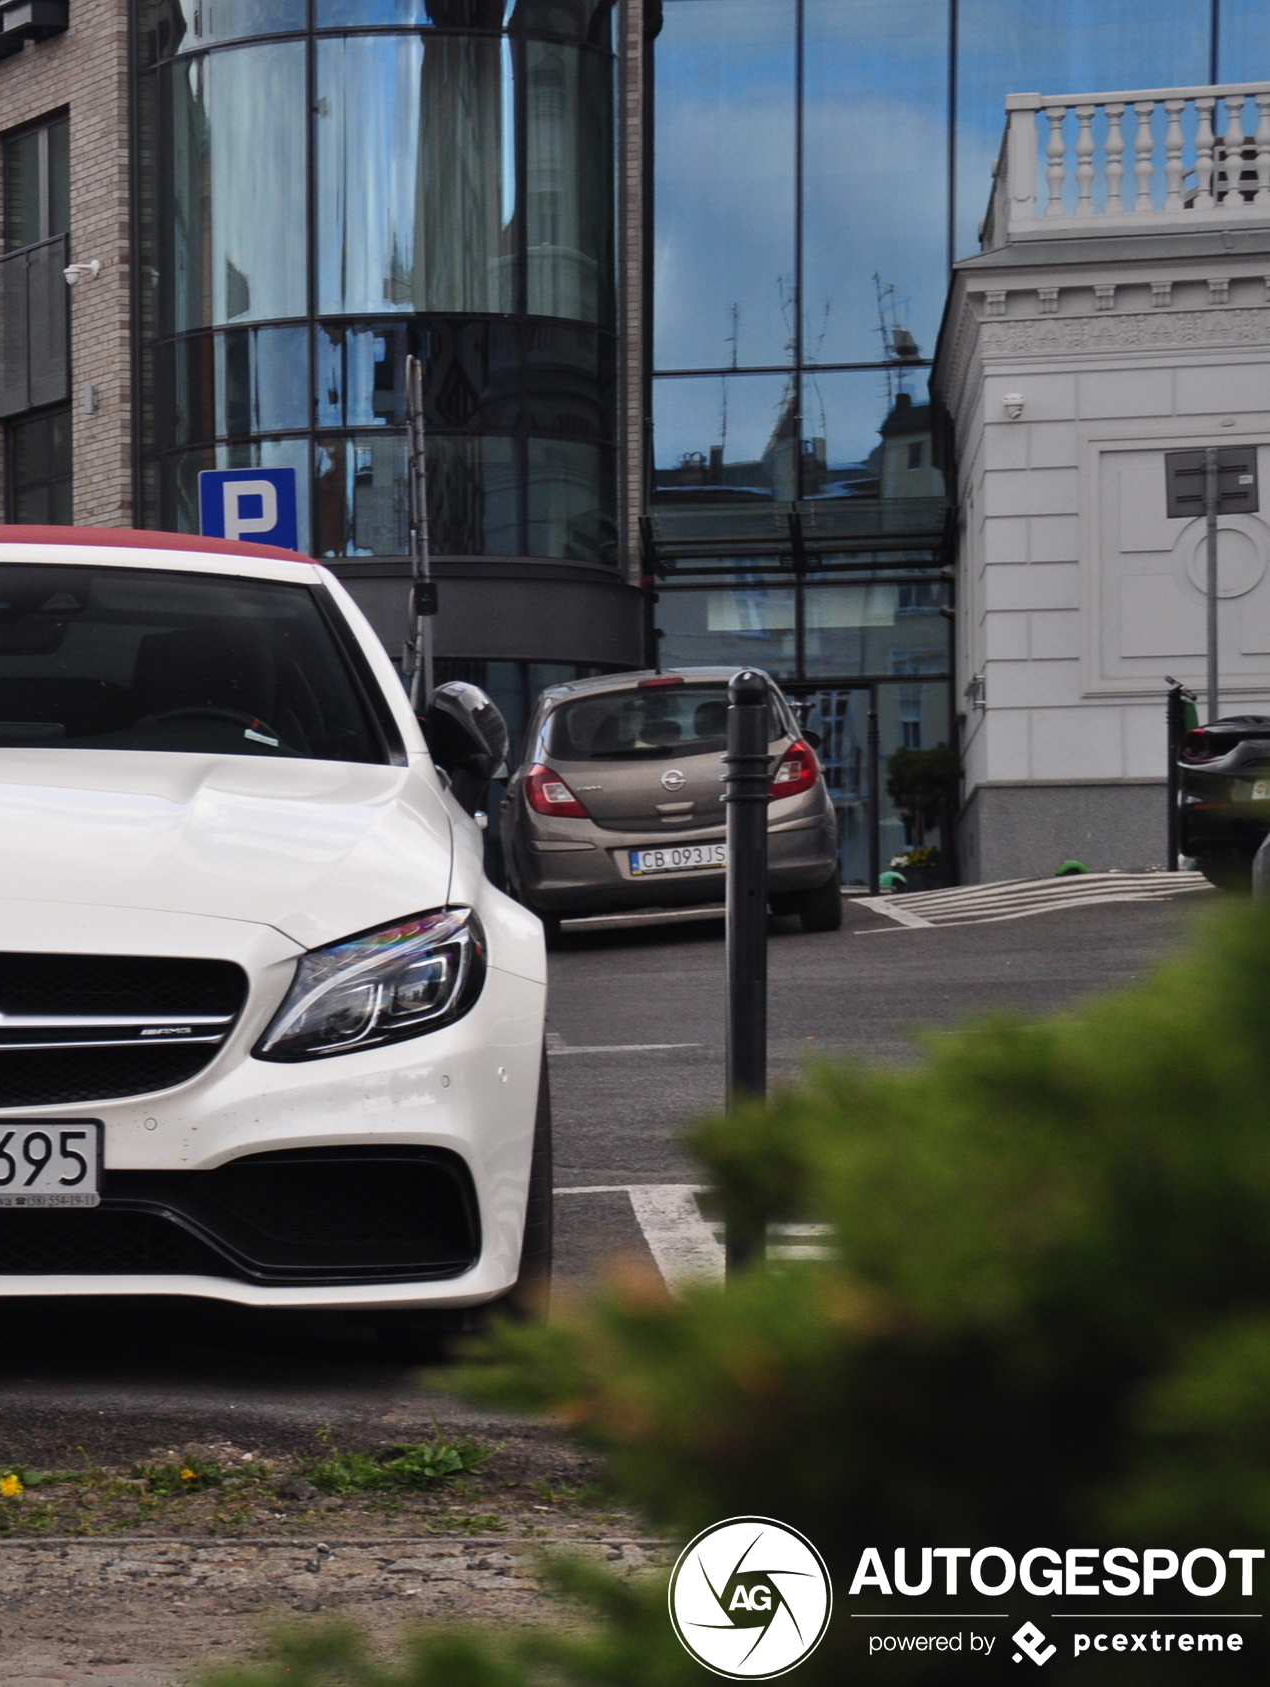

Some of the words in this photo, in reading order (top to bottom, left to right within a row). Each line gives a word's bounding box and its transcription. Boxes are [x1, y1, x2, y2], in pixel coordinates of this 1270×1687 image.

[223, 480, 277, 541] P
[642, 851, 665, 868] CB
[671, 845, 726, 866] 093JS
